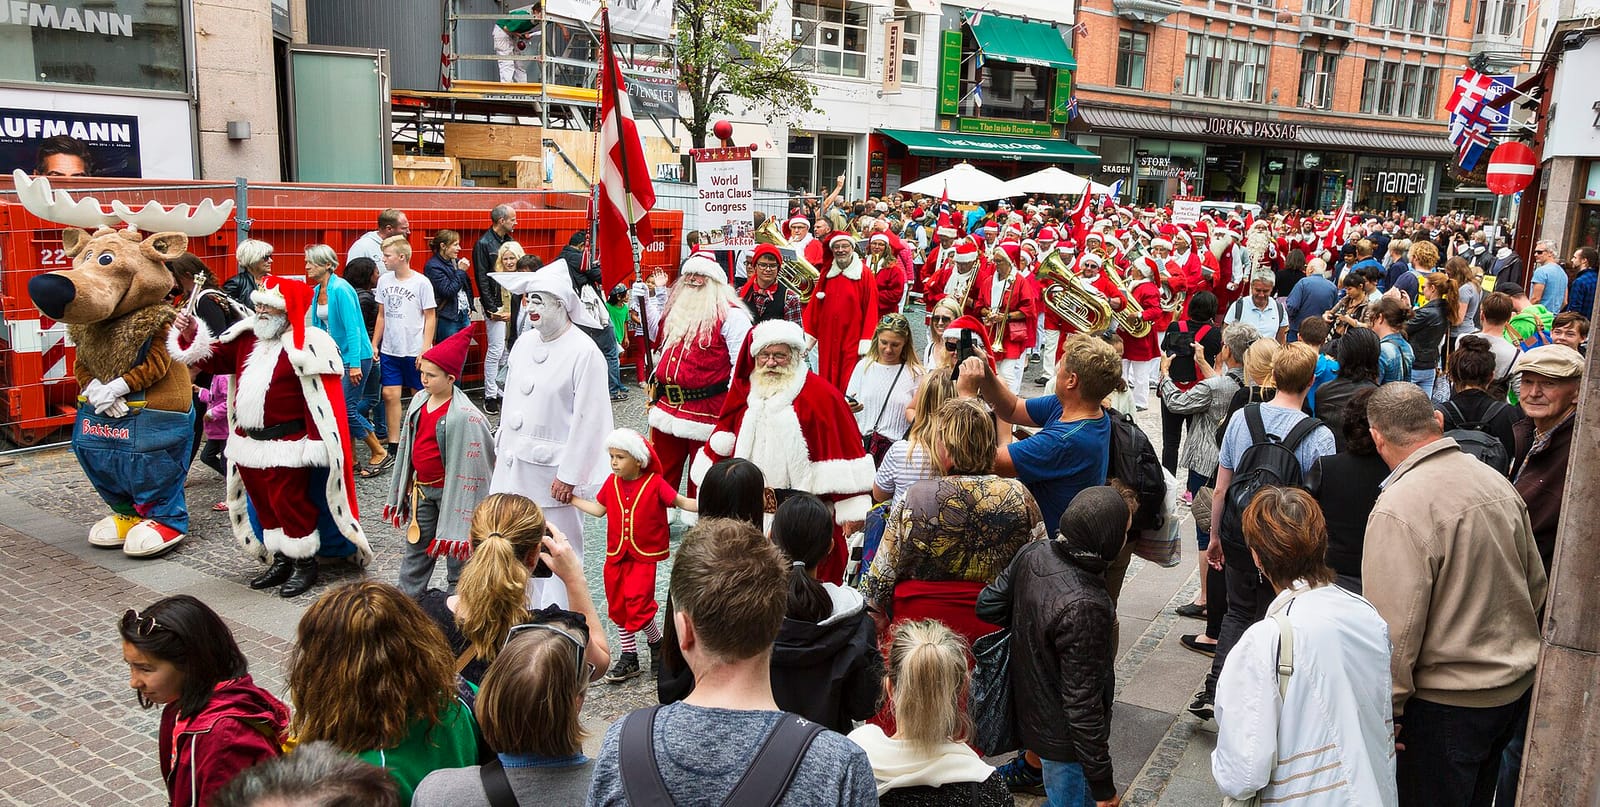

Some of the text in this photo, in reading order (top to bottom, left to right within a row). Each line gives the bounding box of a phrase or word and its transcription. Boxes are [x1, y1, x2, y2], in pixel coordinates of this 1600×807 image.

[889, 26, 898, 82] baresso
[0, 118, 130, 142] UFMANN
[979, 122, 992, 131] The
[994, 124, 1011, 133] Irish
[1012, 125, 1034, 134] Rover
[1254, 121, 1301, 140] PASSAGE
[1141, 156, 1171, 167] STORY
[1102, 164, 1131, 174] SKAGEN
[711, 174, 738, 186] World
[1376, 171, 1417, 194] name
[699, 187, 752, 199] Santa Claus
[704, 202, 747, 214] Congress
[724, 236, 753, 246] Bakken
[40, 249, 67, 265] 22
[382, 286, 416, 302] EXTREME
[82, 418, 130, 440] Bakken
